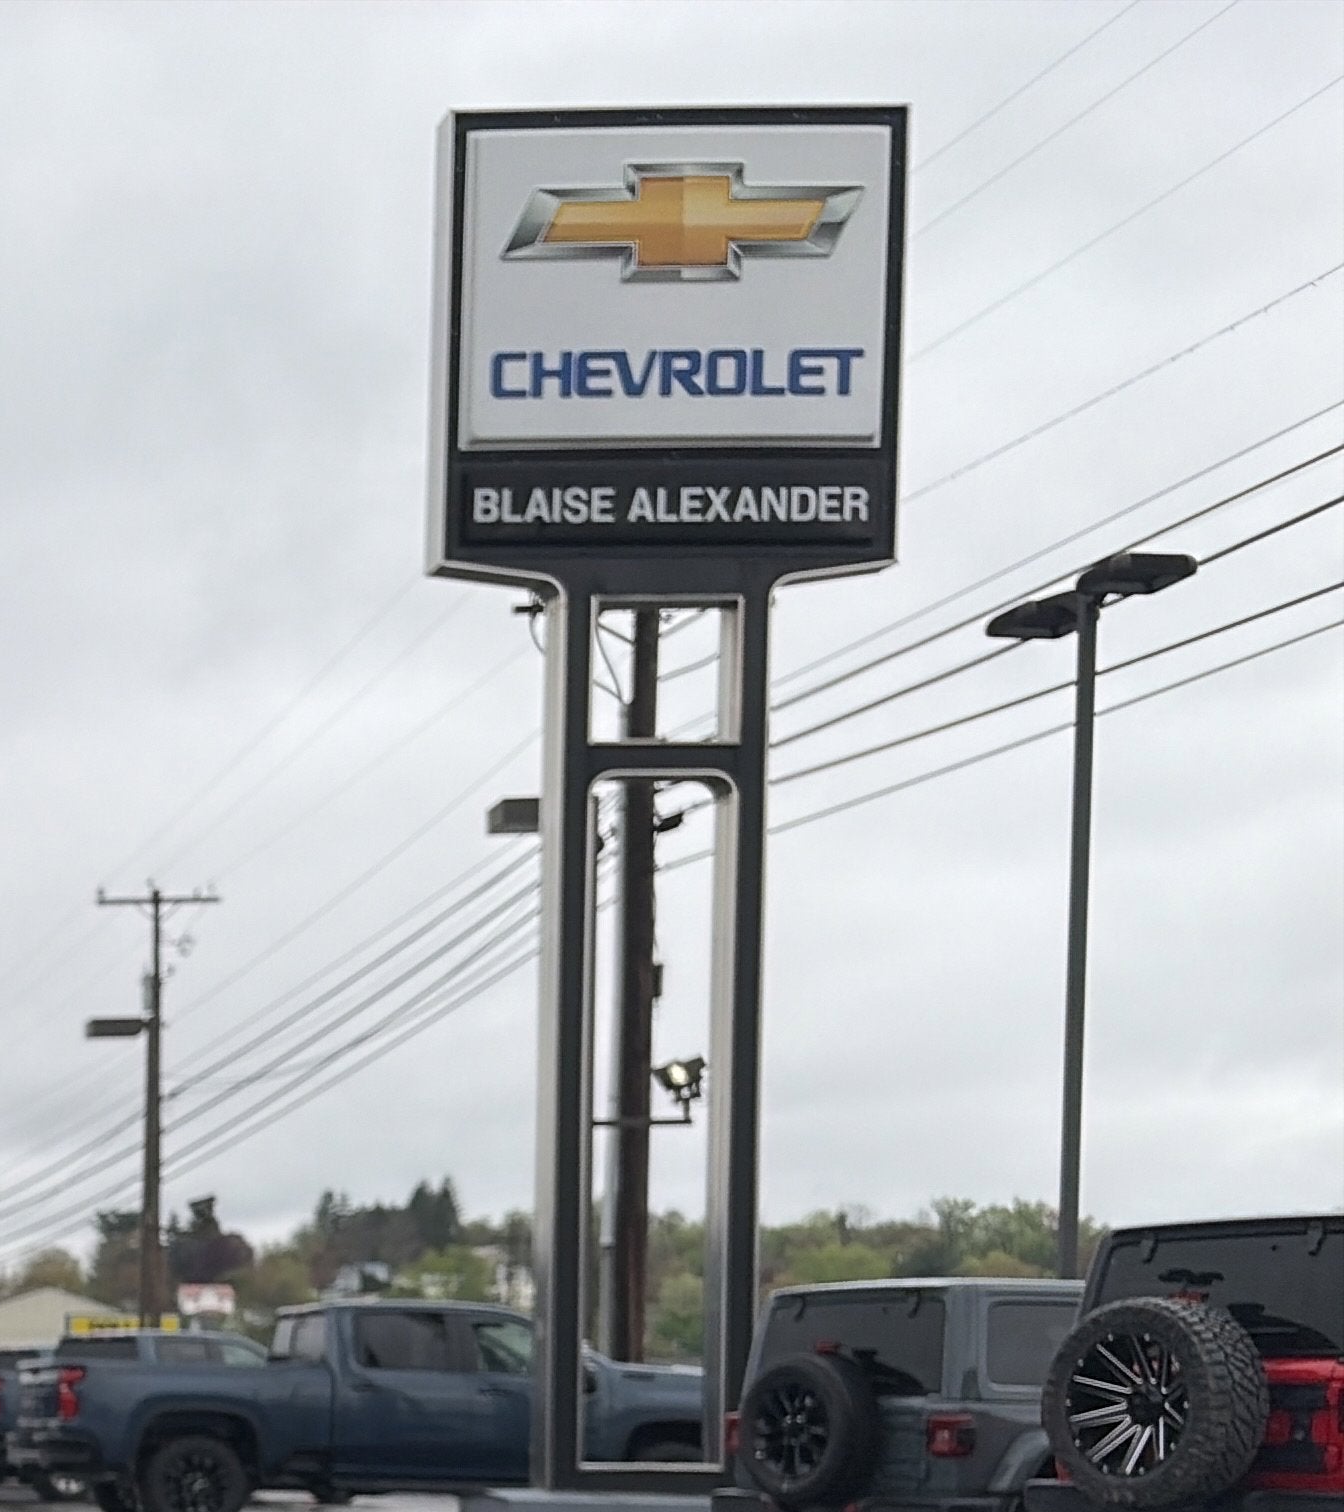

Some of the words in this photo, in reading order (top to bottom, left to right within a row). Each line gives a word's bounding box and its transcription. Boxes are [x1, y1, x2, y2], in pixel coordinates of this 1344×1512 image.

[491, 348, 864, 397] CHEVROLET
[473, 486, 615, 524] BLAISE
[627, 485, 869, 523] ALEXANDER
